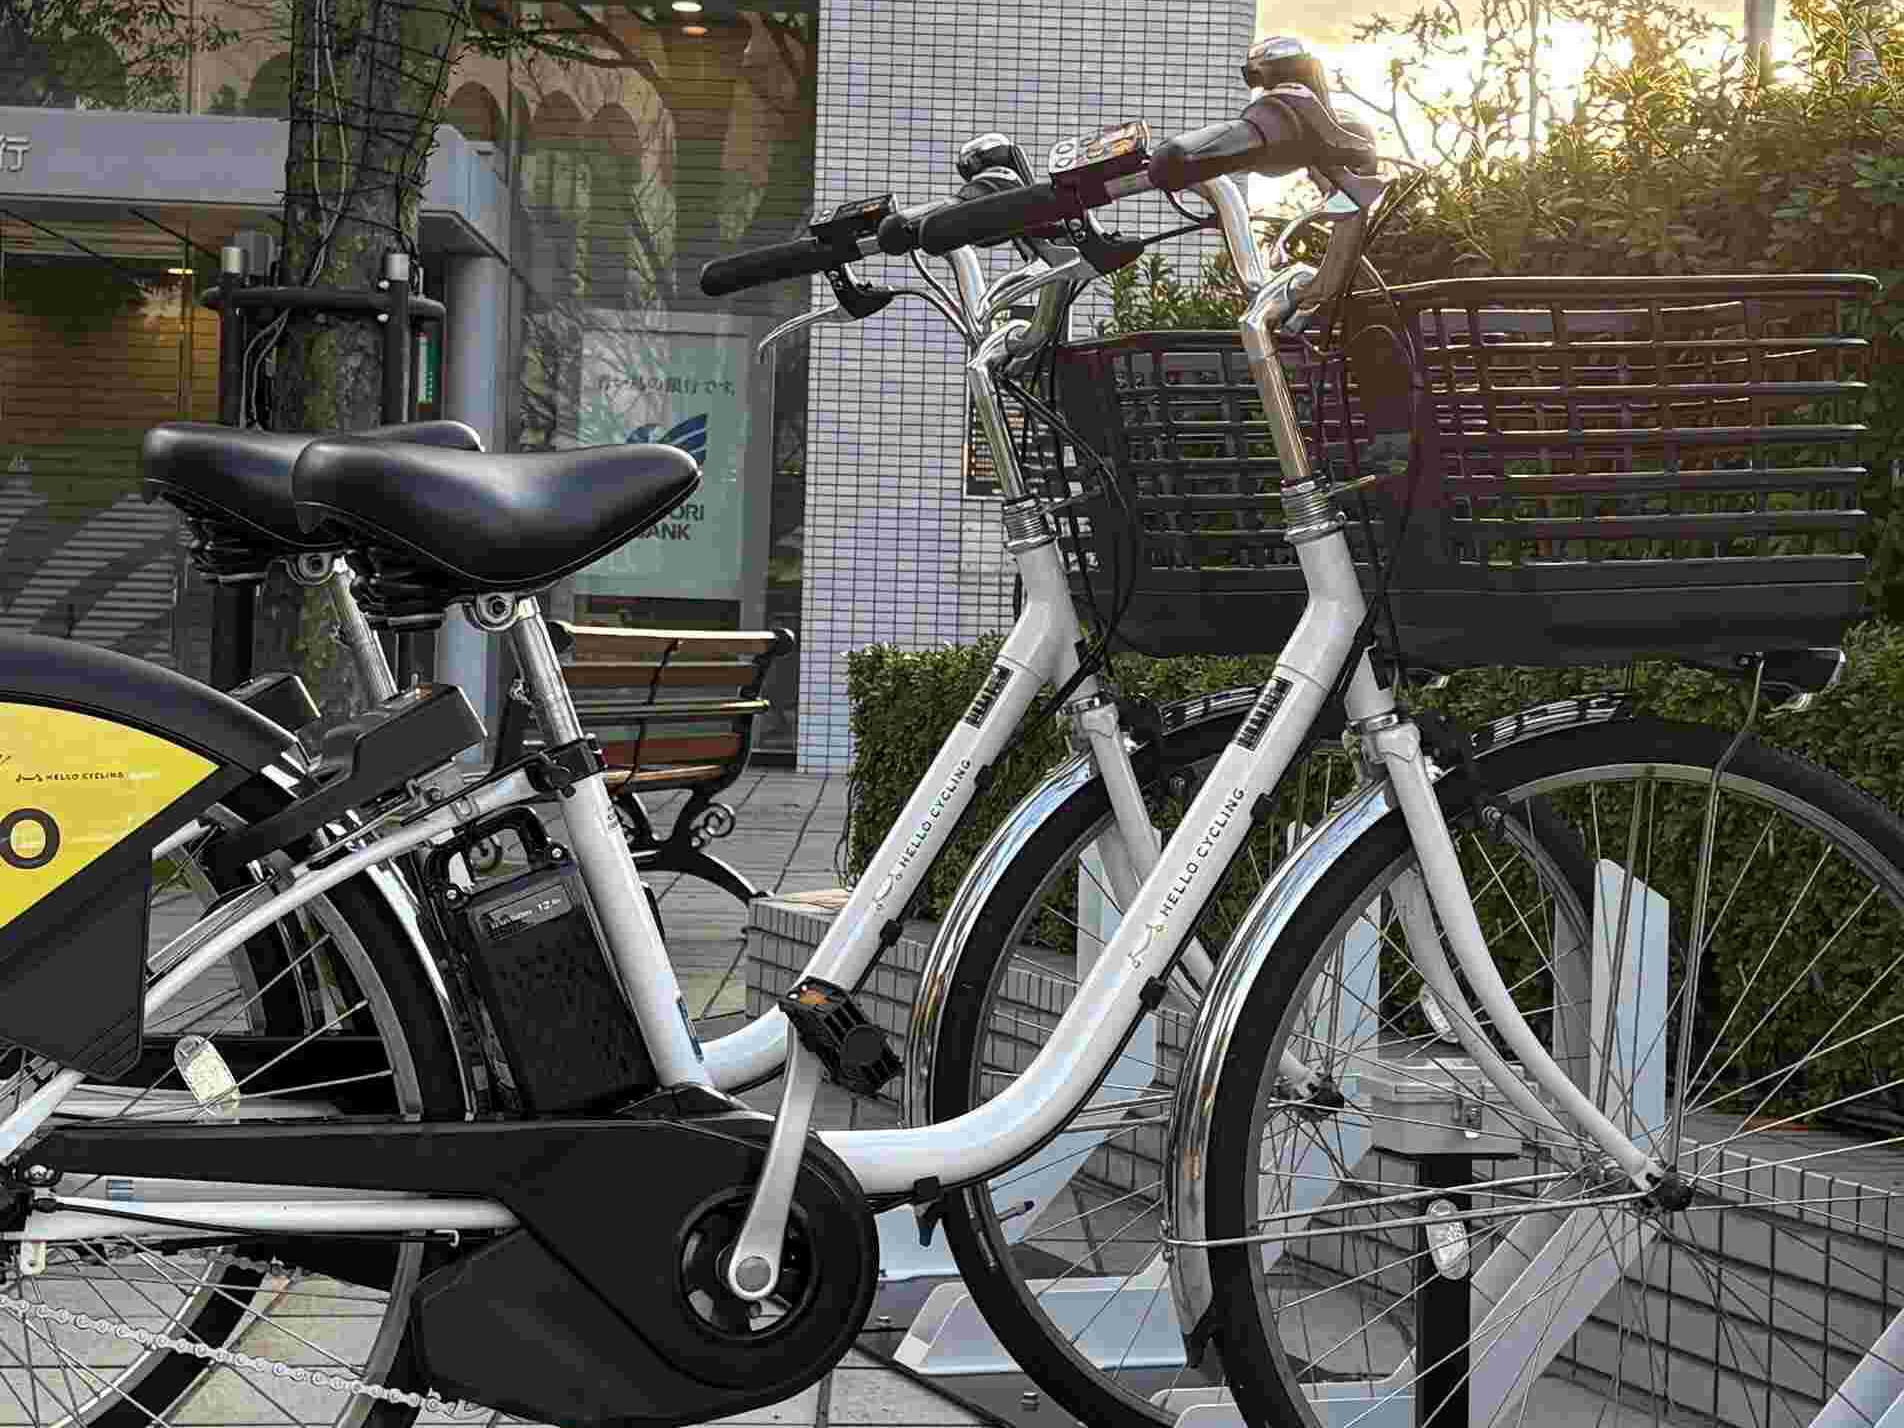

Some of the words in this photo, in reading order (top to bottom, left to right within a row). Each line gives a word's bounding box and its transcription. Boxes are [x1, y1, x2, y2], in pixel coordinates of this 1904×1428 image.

[645, 523, 691, 541] ANK
[899, 818, 933, 870] HELLO
[929, 758, 972, 819] CYCLING
[1159, 861, 1198, 917] HELLO
[1195, 786, 1246, 859] CYCLING
